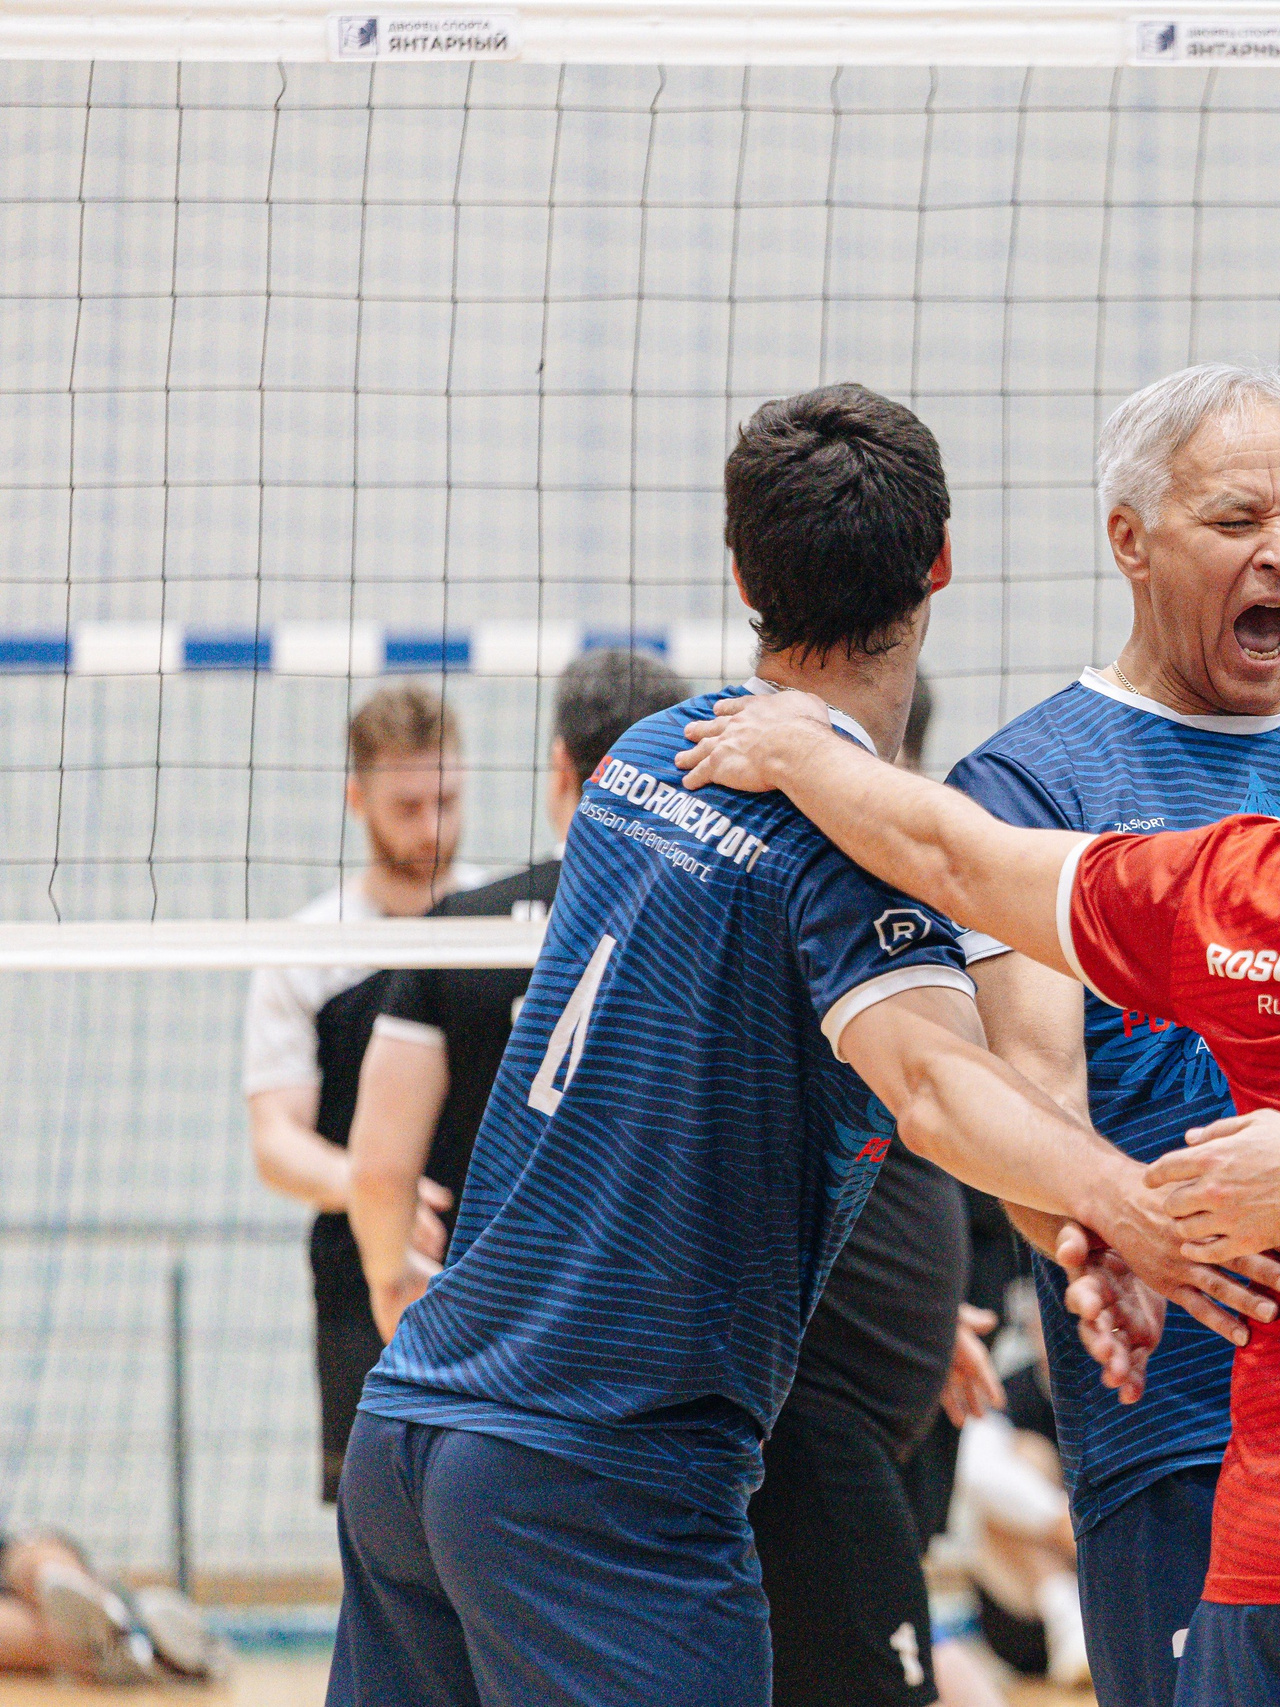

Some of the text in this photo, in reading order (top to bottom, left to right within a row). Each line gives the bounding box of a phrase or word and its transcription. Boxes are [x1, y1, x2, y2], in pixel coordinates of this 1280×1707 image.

[388, 19, 490, 33] ДВОРЕЦ СПОРТА
[388, 33, 509, 53] ЯНТАРНЫЙ
[578, 794, 626, 832] Russian
